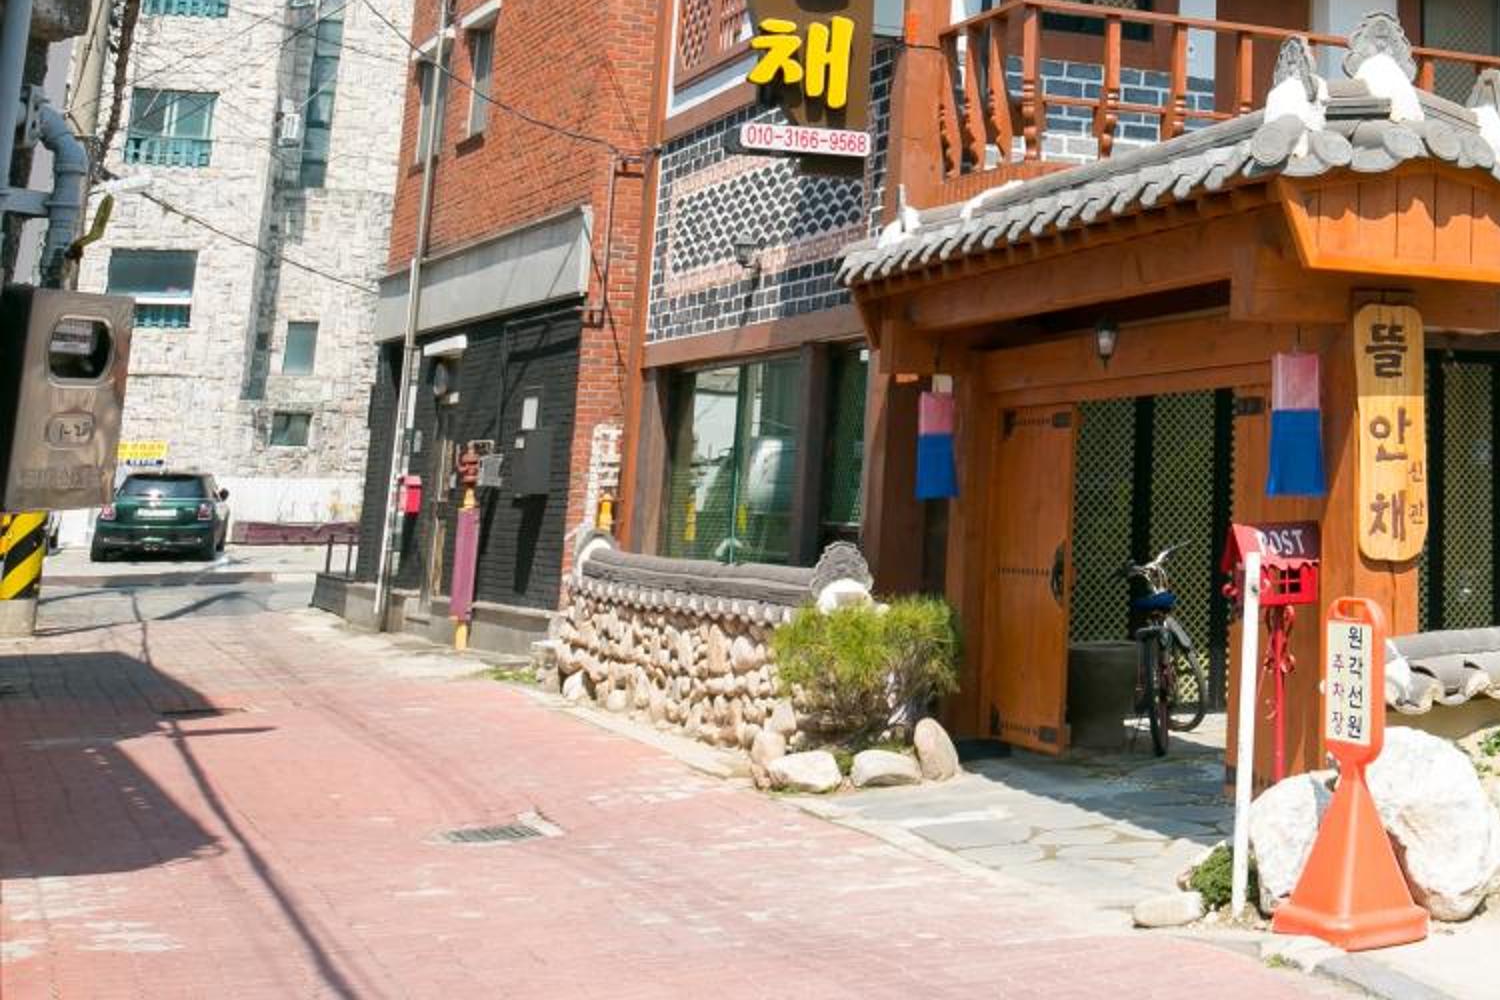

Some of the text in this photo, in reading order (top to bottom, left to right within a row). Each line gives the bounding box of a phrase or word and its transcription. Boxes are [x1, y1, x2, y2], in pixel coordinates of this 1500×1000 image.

[746, 126, 868, 154] 010-3166-9568
[1365, 323, 1412, 542] 뜰안채
[1257, 528, 1305, 555] POST
[1332, 653, 1345, 735] 주차장
[1347, 625, 1363, 739] 원각선원
